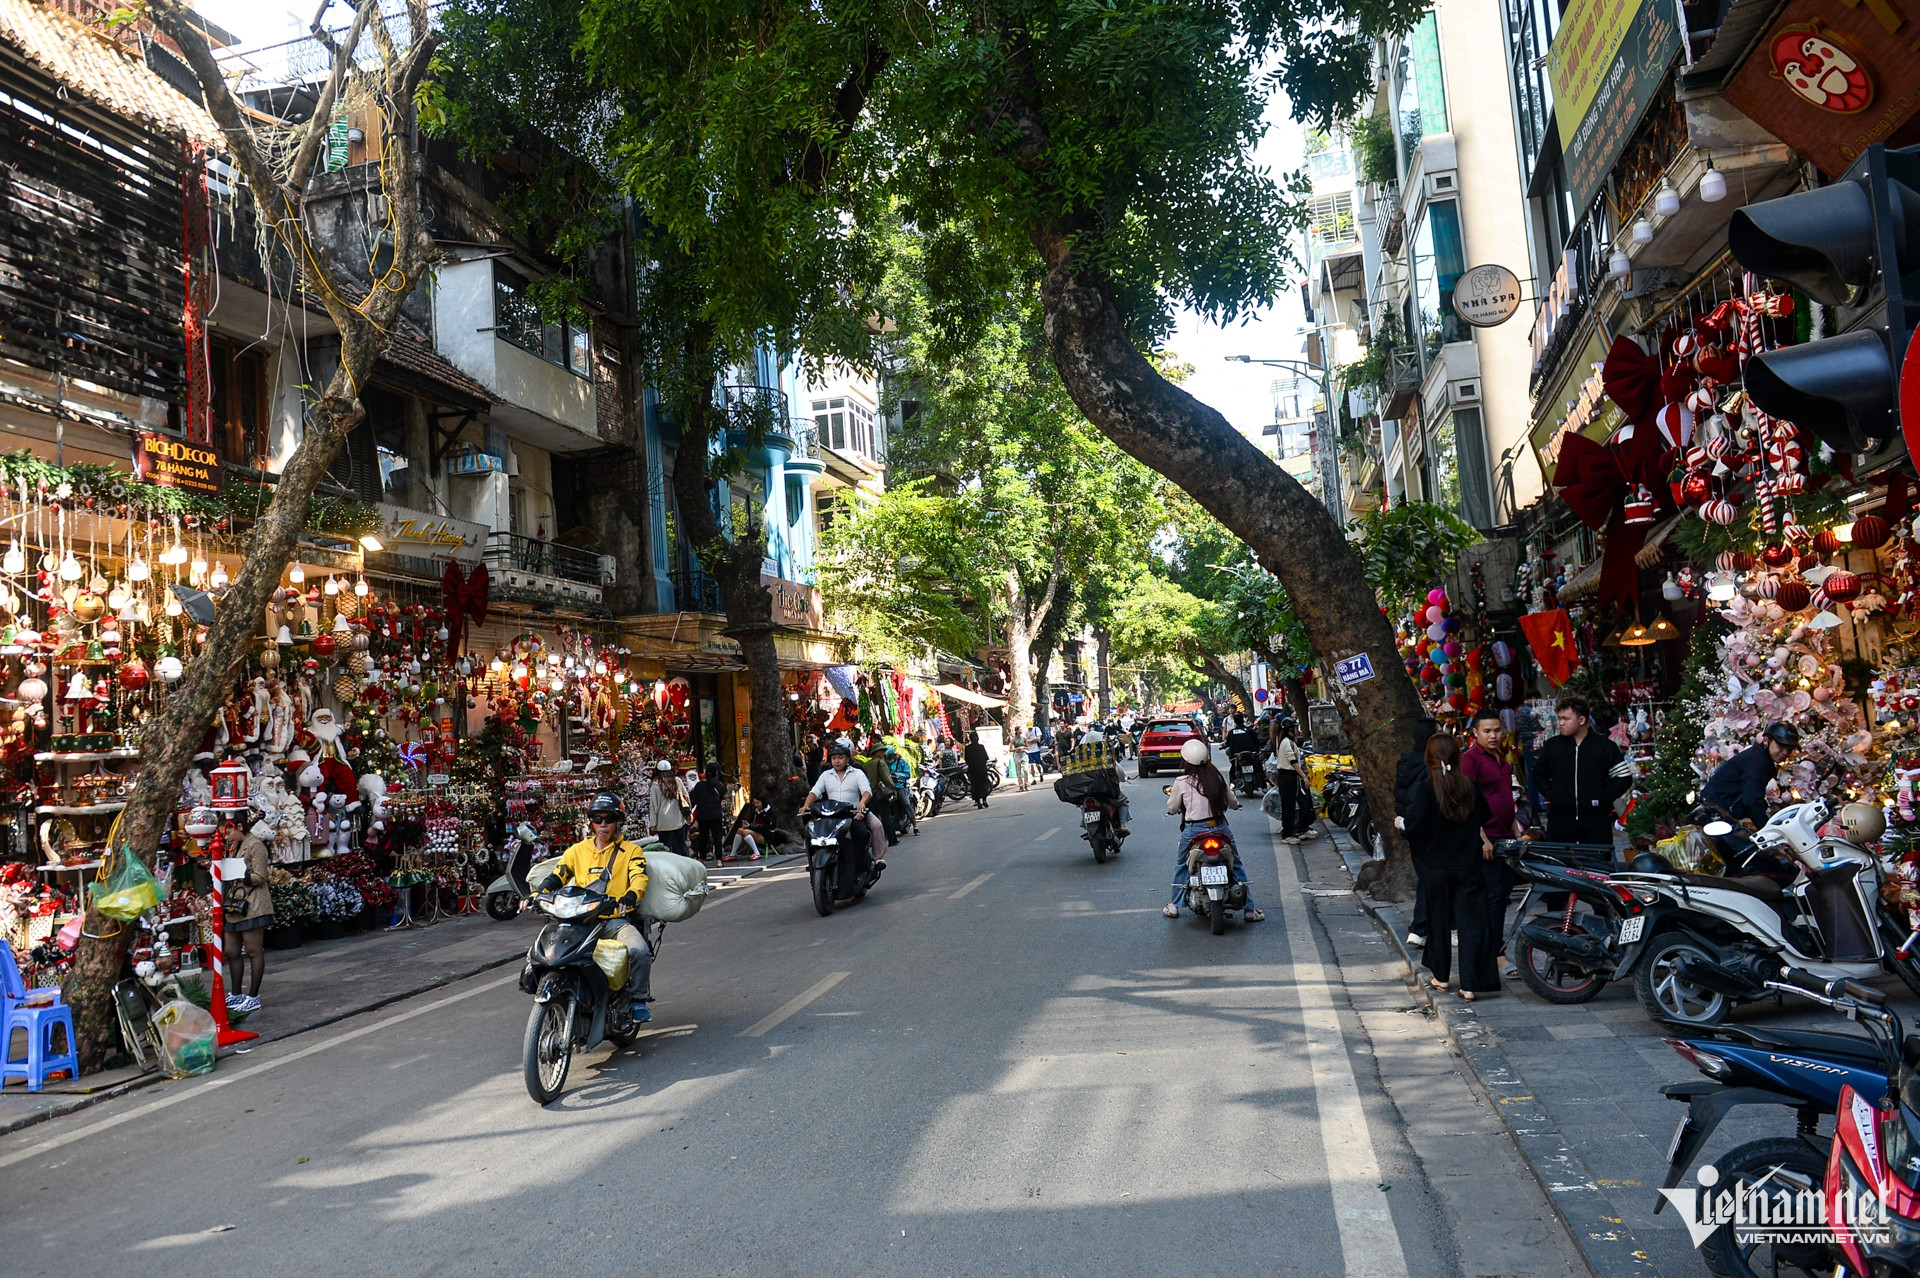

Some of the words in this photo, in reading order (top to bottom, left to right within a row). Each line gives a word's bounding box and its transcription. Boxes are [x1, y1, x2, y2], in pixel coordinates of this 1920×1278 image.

[1492, 293, 1516, 304] SPA
[156, 460, 166, 471] 78
[168, 462, 194, 476] HÀNG
[196, 468, 209, 480] MÃ
[1349, 658, 1361, 670] 77
[1342, 672, 1359, 682] HÀNG
[1358, 667, 1370, 676] MÃ
[1770, 1055, 1849, 1076] VISION
